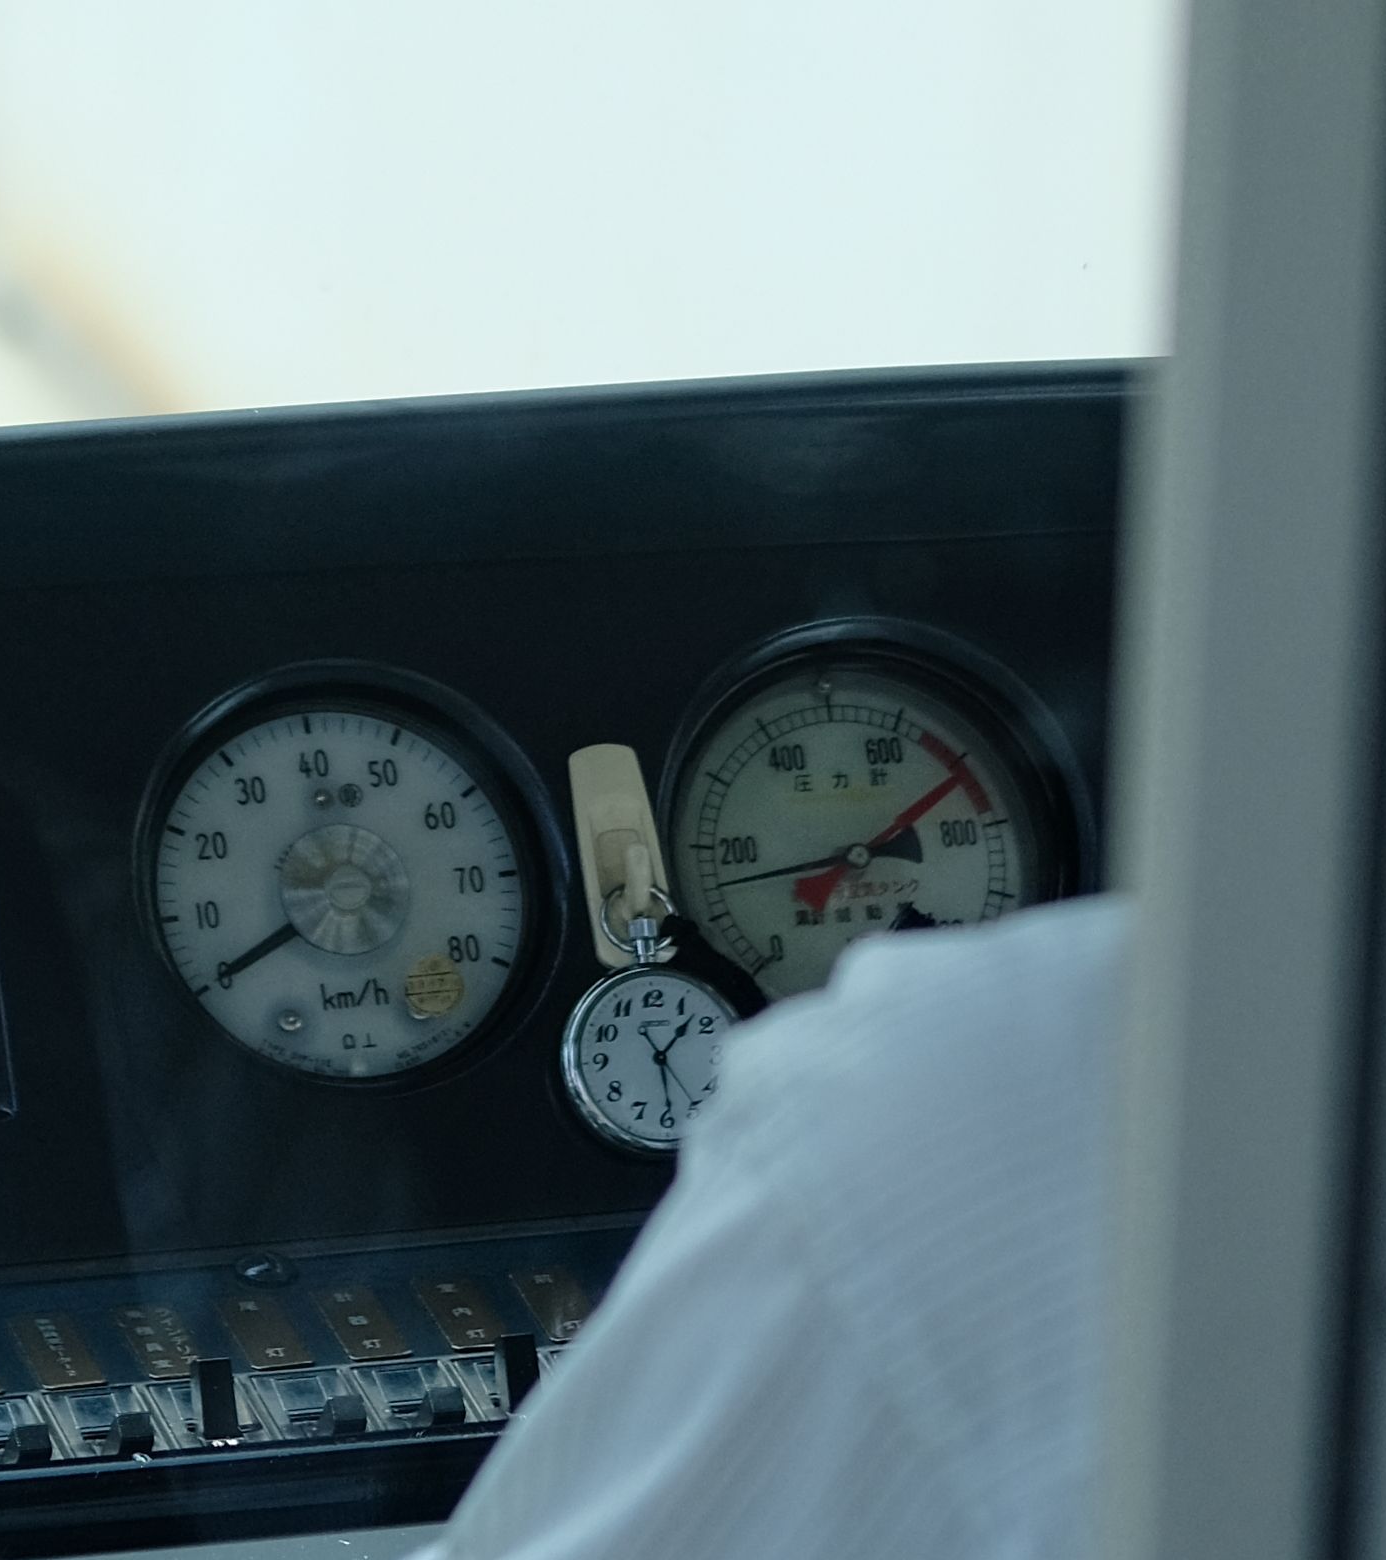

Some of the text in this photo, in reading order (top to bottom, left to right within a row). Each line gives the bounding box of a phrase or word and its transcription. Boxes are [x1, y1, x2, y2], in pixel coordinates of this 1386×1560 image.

[297, 749, 330, 778] 40
[768, 744, 805, 772] 400
[865, 737, 903, 765] 600
[367, 760, 399, 788] 50
[235, 776, 267, 806] 30
[423, 802, 456, 830] 60
[195, 831, 228, 861] 20
[939, 820, 978, 848] 800
[720, 837, 758, 864] 200
[453, 865, 485, 895] 70
[197, 901, 220, 930] 10
[447, 934, 480, 964] 80
[321, 977, 390, 1011] km/h
[613, 997, 633, 1018] 11
[642, 989, 664, 1009] 12
[676, 996, 686, 1016] 1
[595, 1023, 619, 1043] 10
[698, 1015, 715, 1035] 2
[592, 1052, 609, 1072] 9
[606, 1080, 623, 1102] 8
[631, 1100, 648, 1121] 7
[659, 1107, 676, 1129] 6
